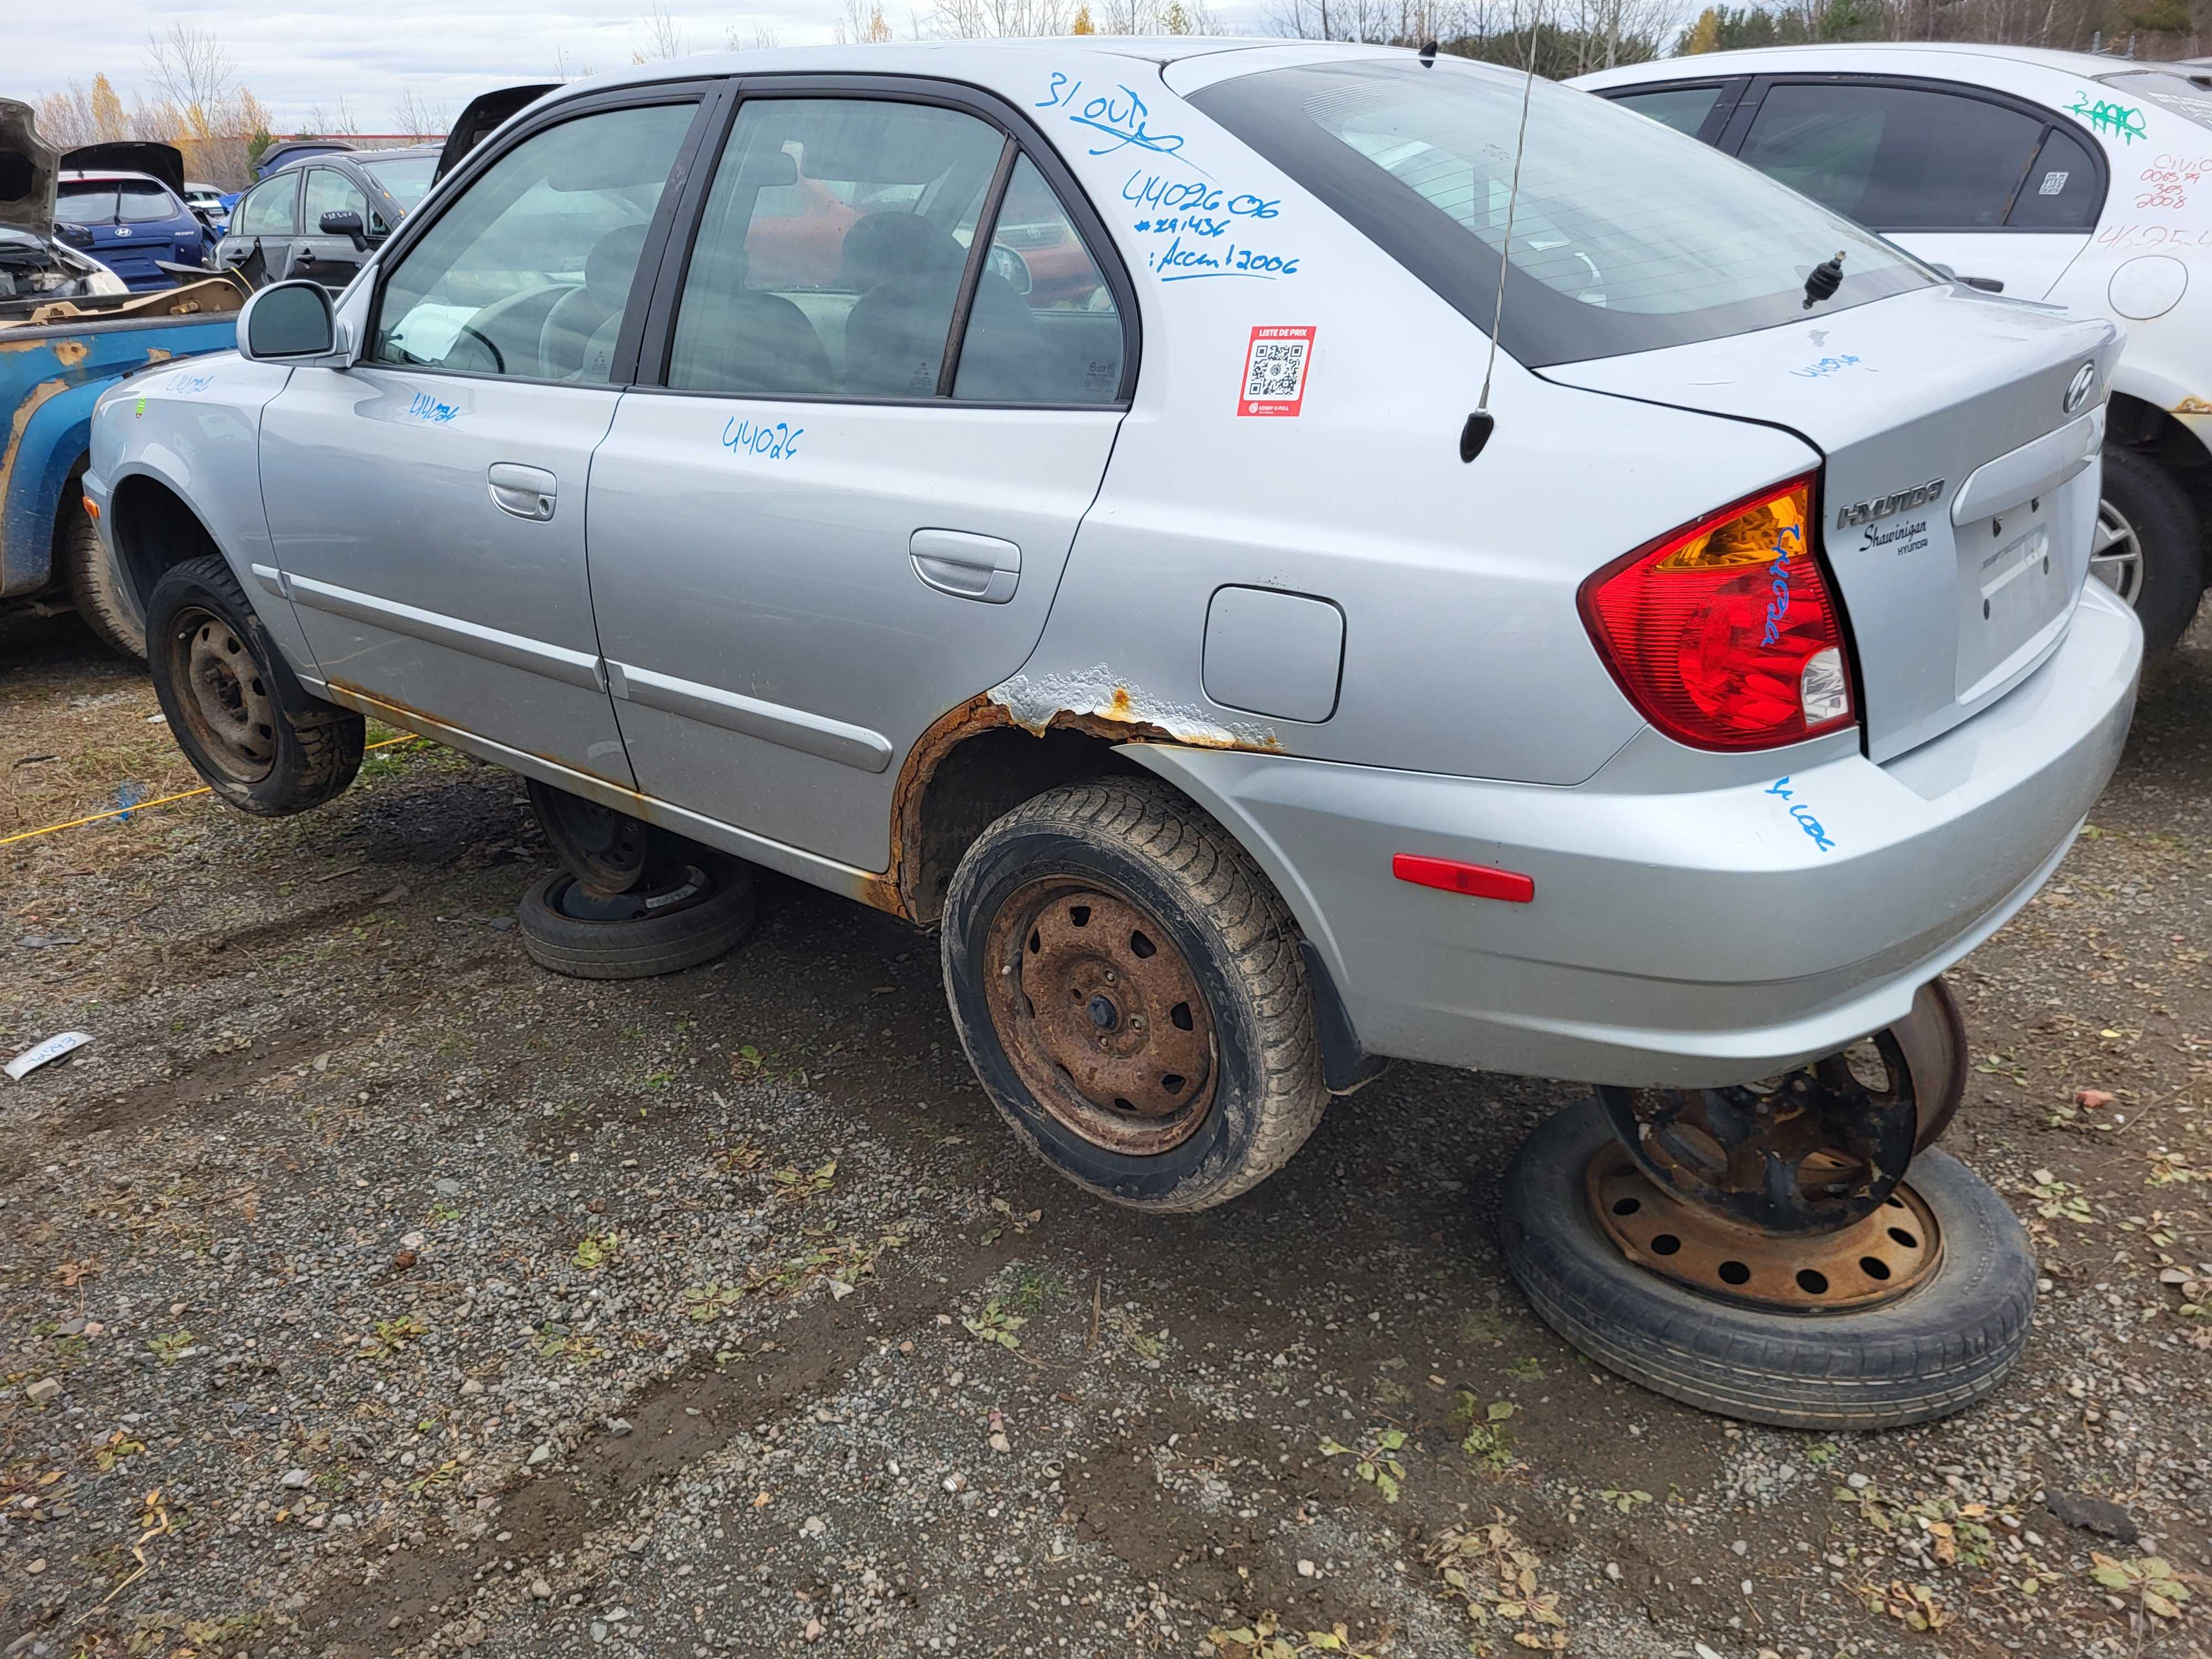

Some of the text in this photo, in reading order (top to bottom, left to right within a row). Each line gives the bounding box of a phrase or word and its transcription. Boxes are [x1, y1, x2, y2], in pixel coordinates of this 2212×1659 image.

[2134, 194, 2187, 209] 2008
[1236, 251, 1300, 274] 2006
[1259, 328, 1307, 337] LISTE DE PRIX
[722, 415, 805, 461] 44026
[1859, 520, 1927, 552] Shawinigan
[1897, 538, 1928, 556] HYUNDAI
